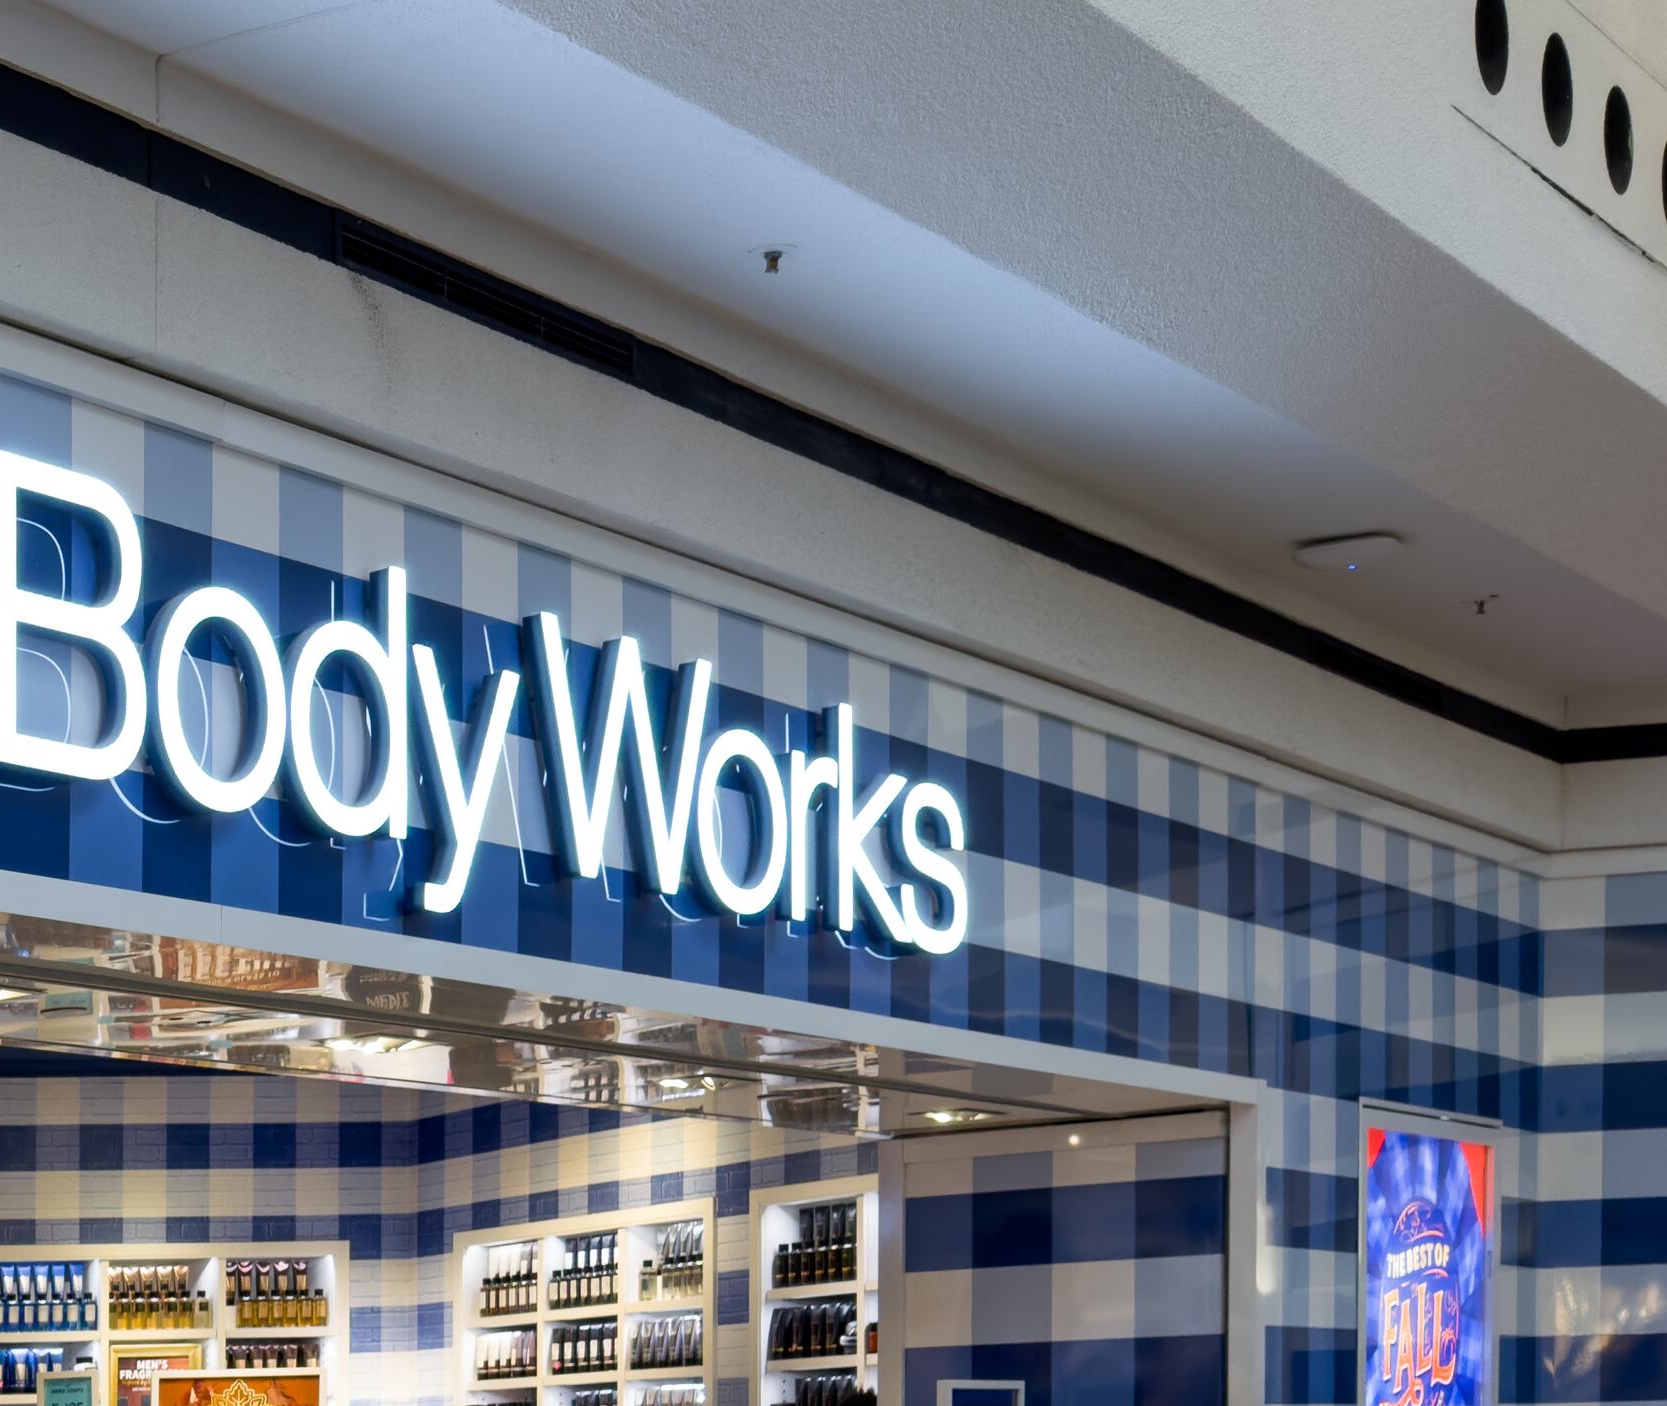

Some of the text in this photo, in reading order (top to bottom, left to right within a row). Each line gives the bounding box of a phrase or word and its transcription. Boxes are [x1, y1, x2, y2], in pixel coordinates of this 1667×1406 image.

[539, 609, 969, 957] Works
[1386, 1243, 1450, 1279] THE BEST OF
[136, 1359, 168, 1370] MEN'S
